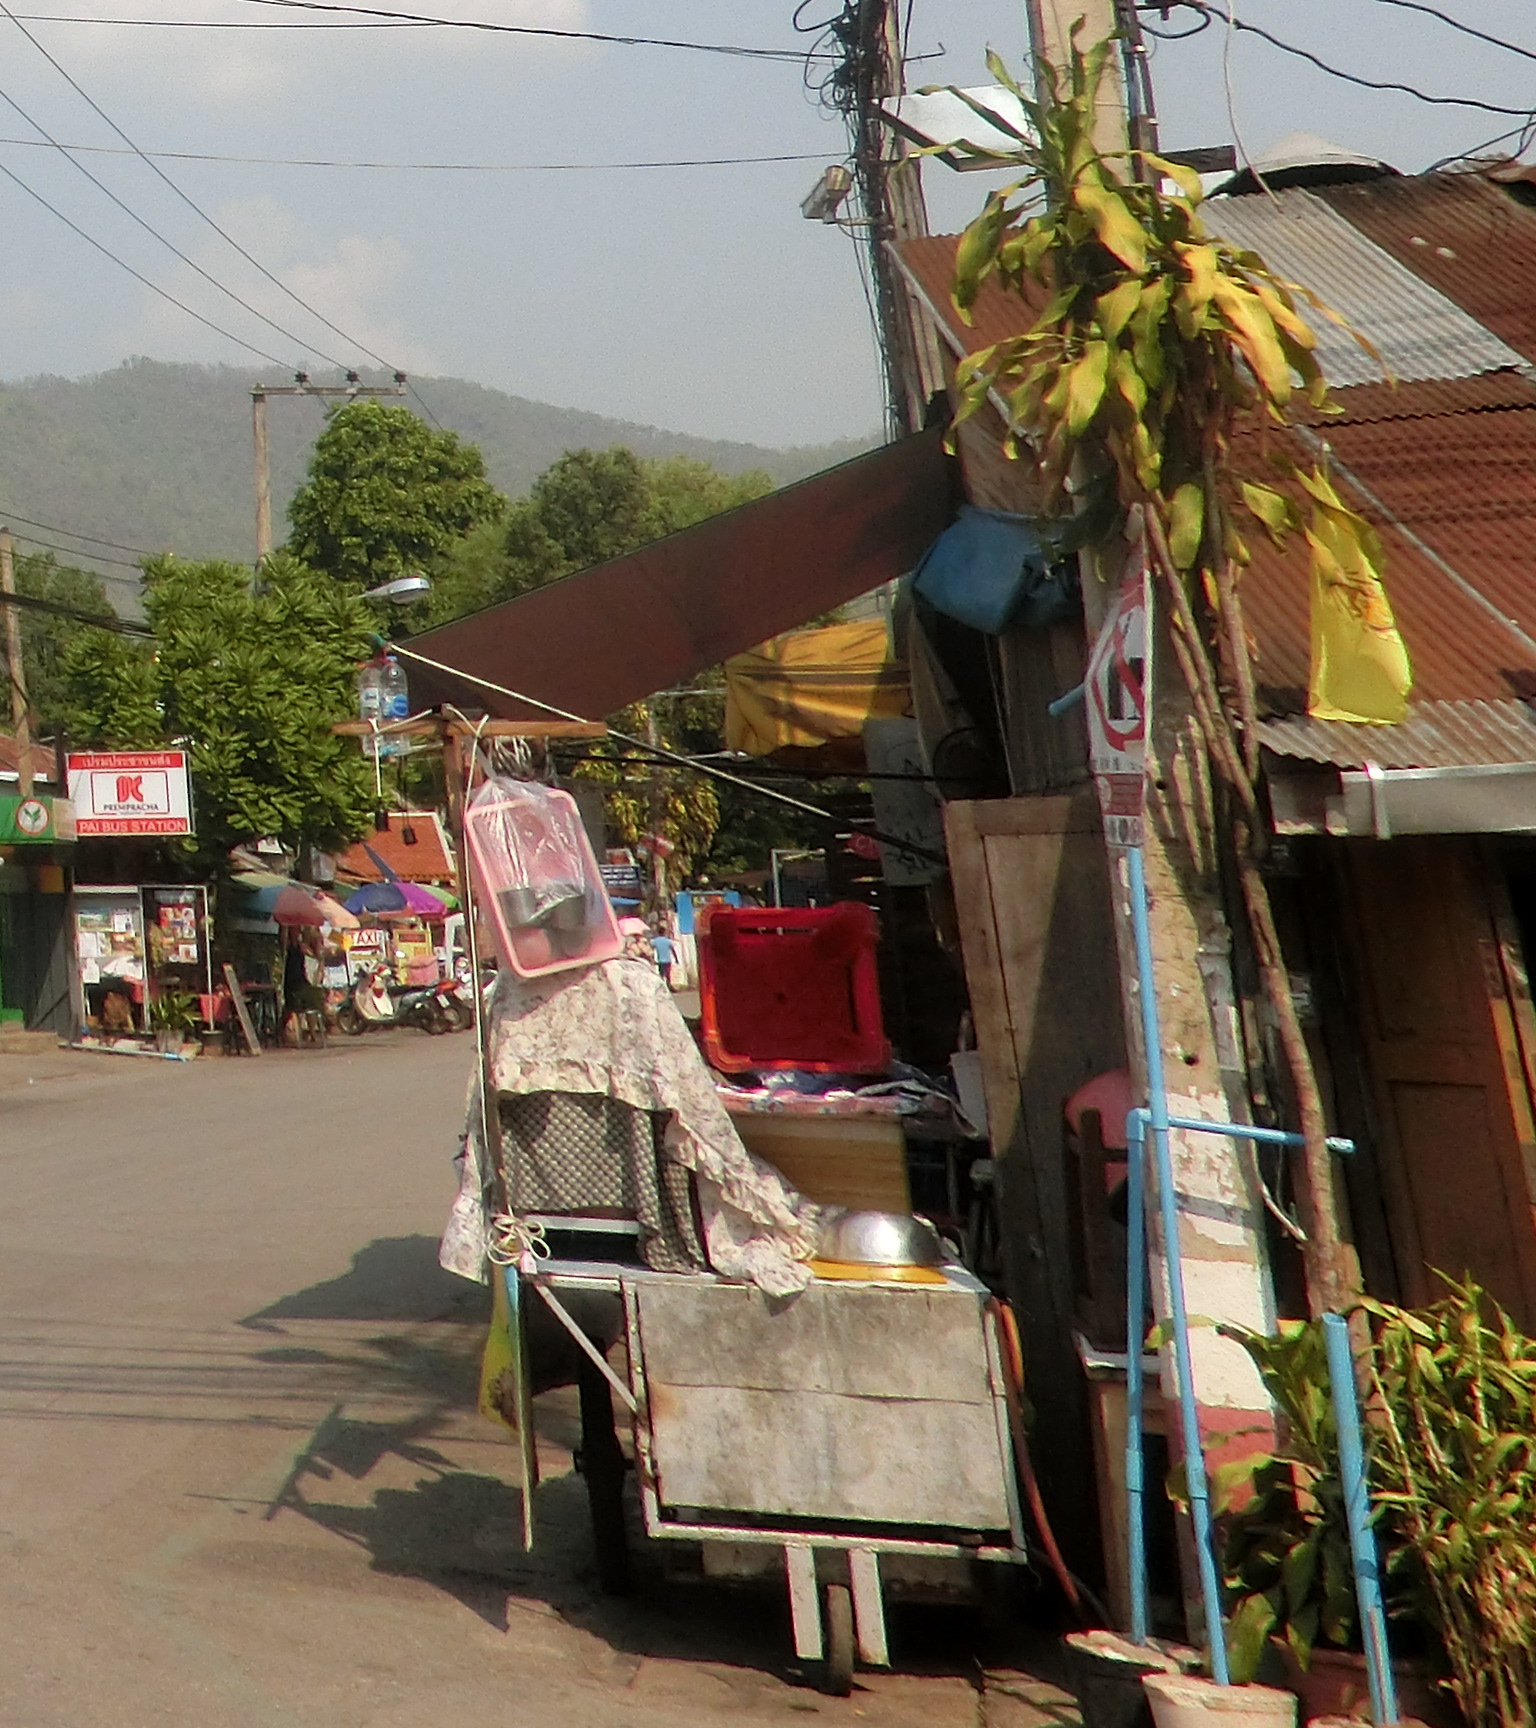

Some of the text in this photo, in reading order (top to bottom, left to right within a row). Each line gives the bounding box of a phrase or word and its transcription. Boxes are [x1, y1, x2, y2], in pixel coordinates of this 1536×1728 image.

[80, 820, 185, 832] PAI BUS STATION
